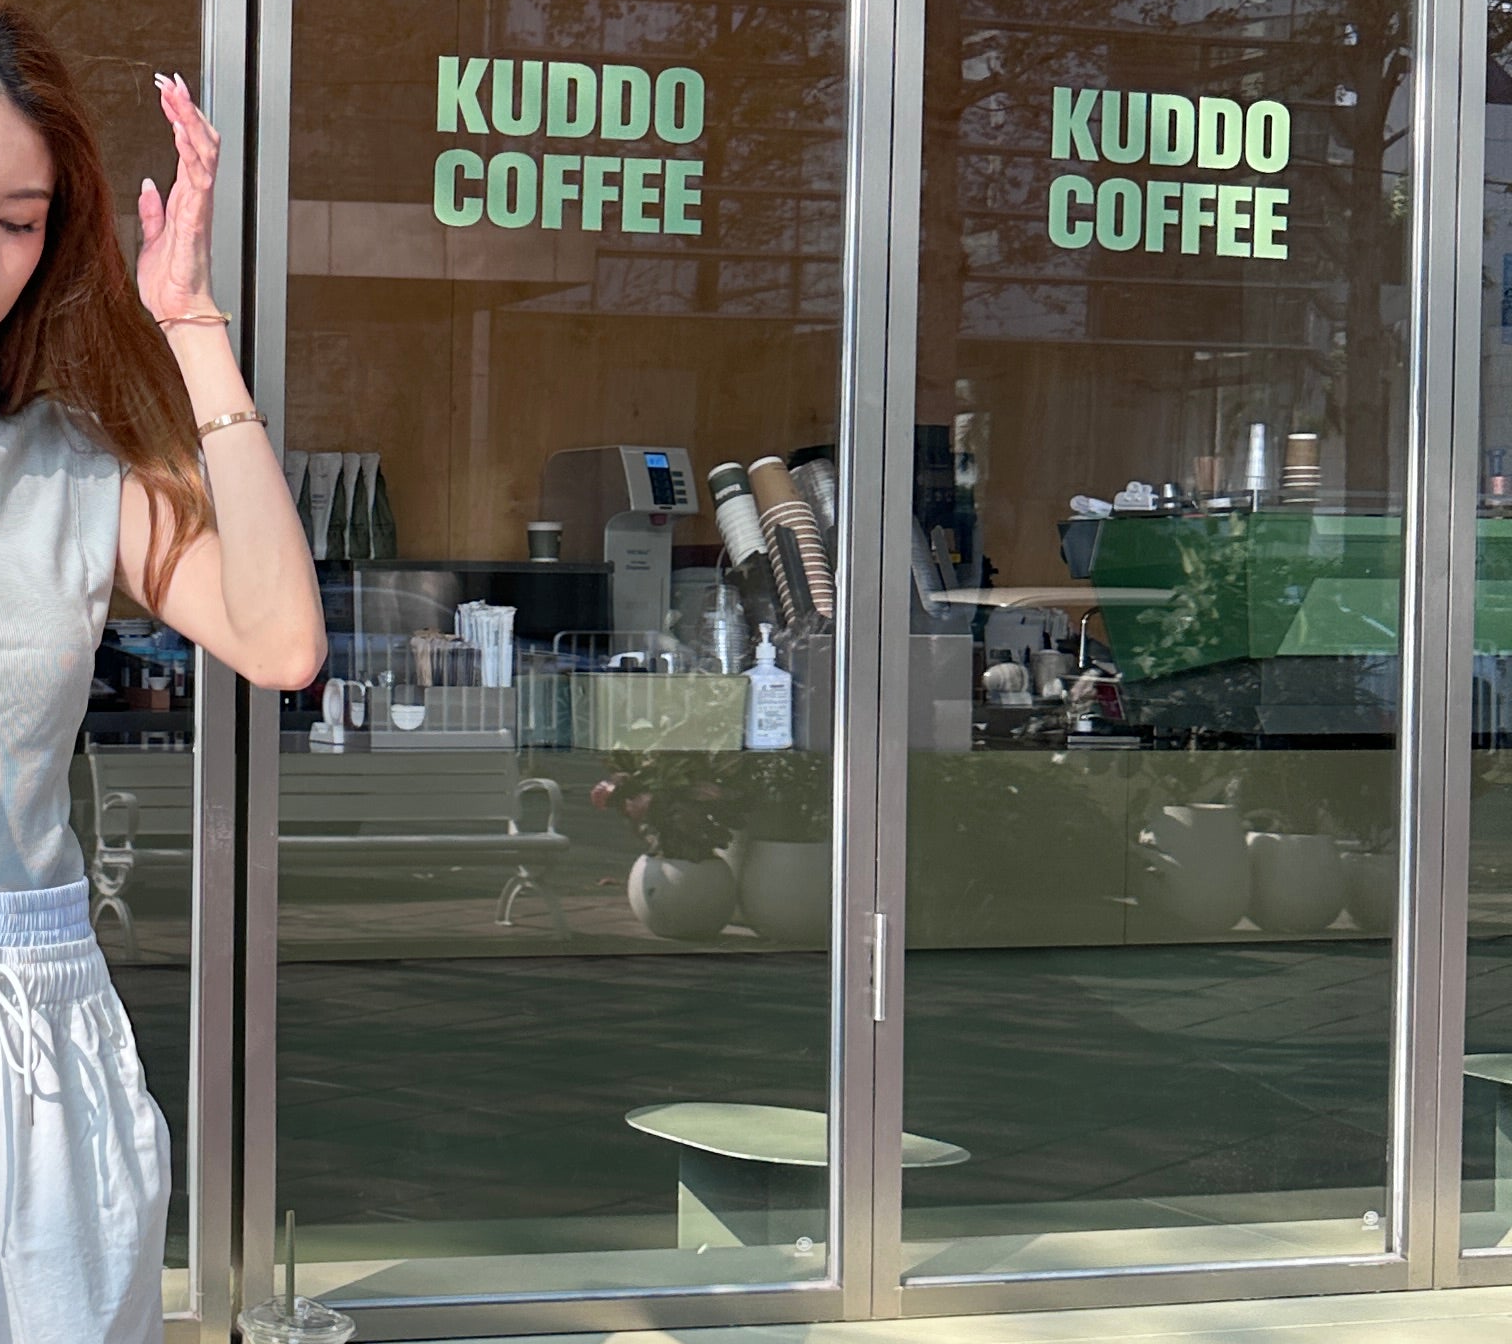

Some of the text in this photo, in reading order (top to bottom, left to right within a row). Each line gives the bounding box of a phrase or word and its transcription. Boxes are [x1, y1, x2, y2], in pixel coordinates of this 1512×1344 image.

[437, 56, 705, 145] KUDDO
[1051, 86, 1291, 173] KUDDO
[434, 148, 705, 236] COFFEE
[1048, 174, 1290, 260] COFFEE
